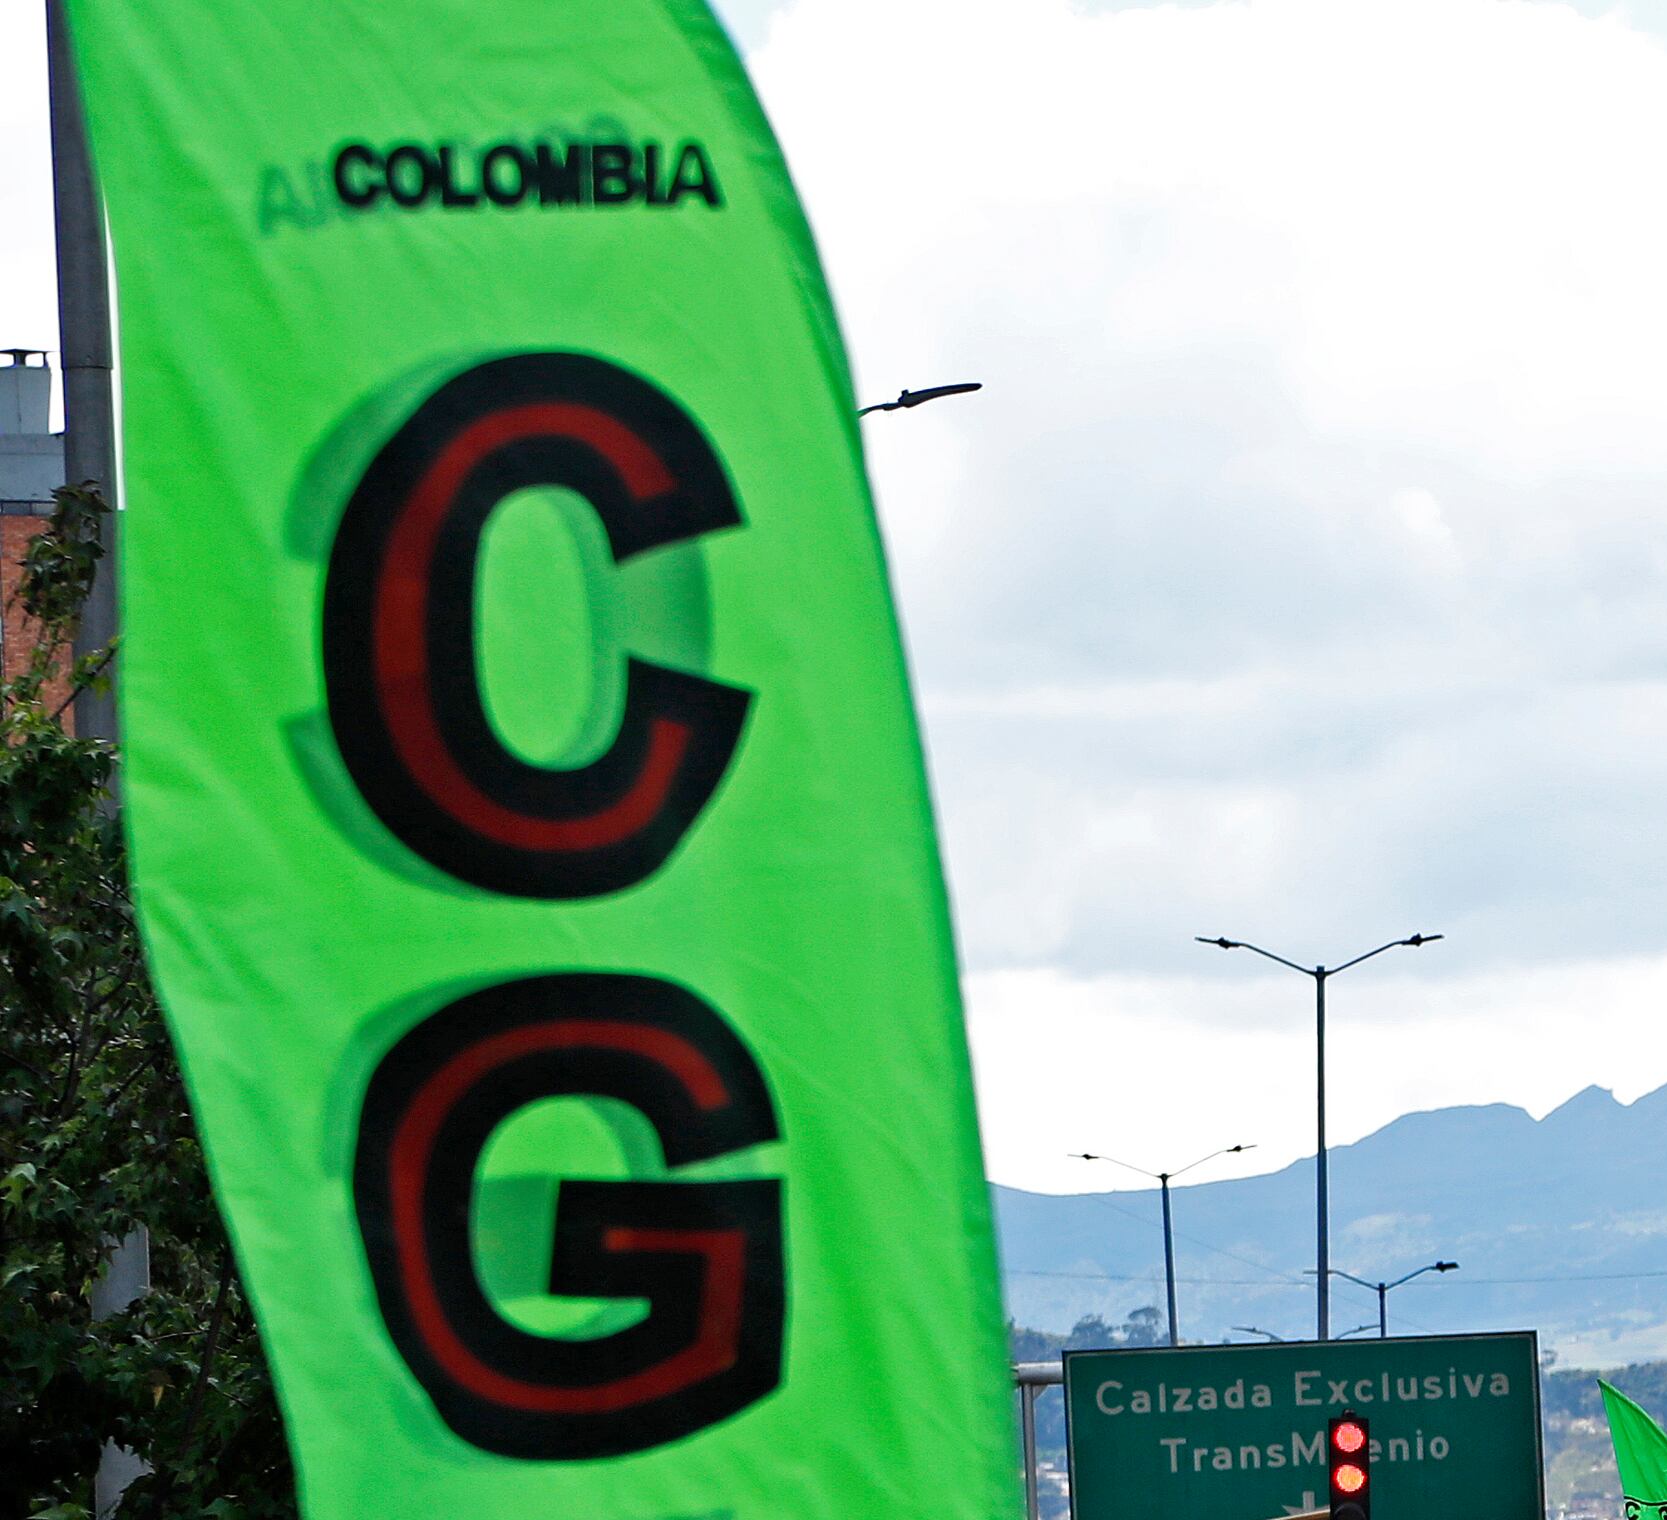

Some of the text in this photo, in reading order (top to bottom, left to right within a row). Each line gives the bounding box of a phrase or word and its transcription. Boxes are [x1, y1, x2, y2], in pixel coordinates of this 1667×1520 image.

[333, 143, 728, 210] COLOMBIA
[1095, 1368, 1511, 1416] Calzada Exclusiva
[1160, 1430, 1451, 1475] TransMenio
